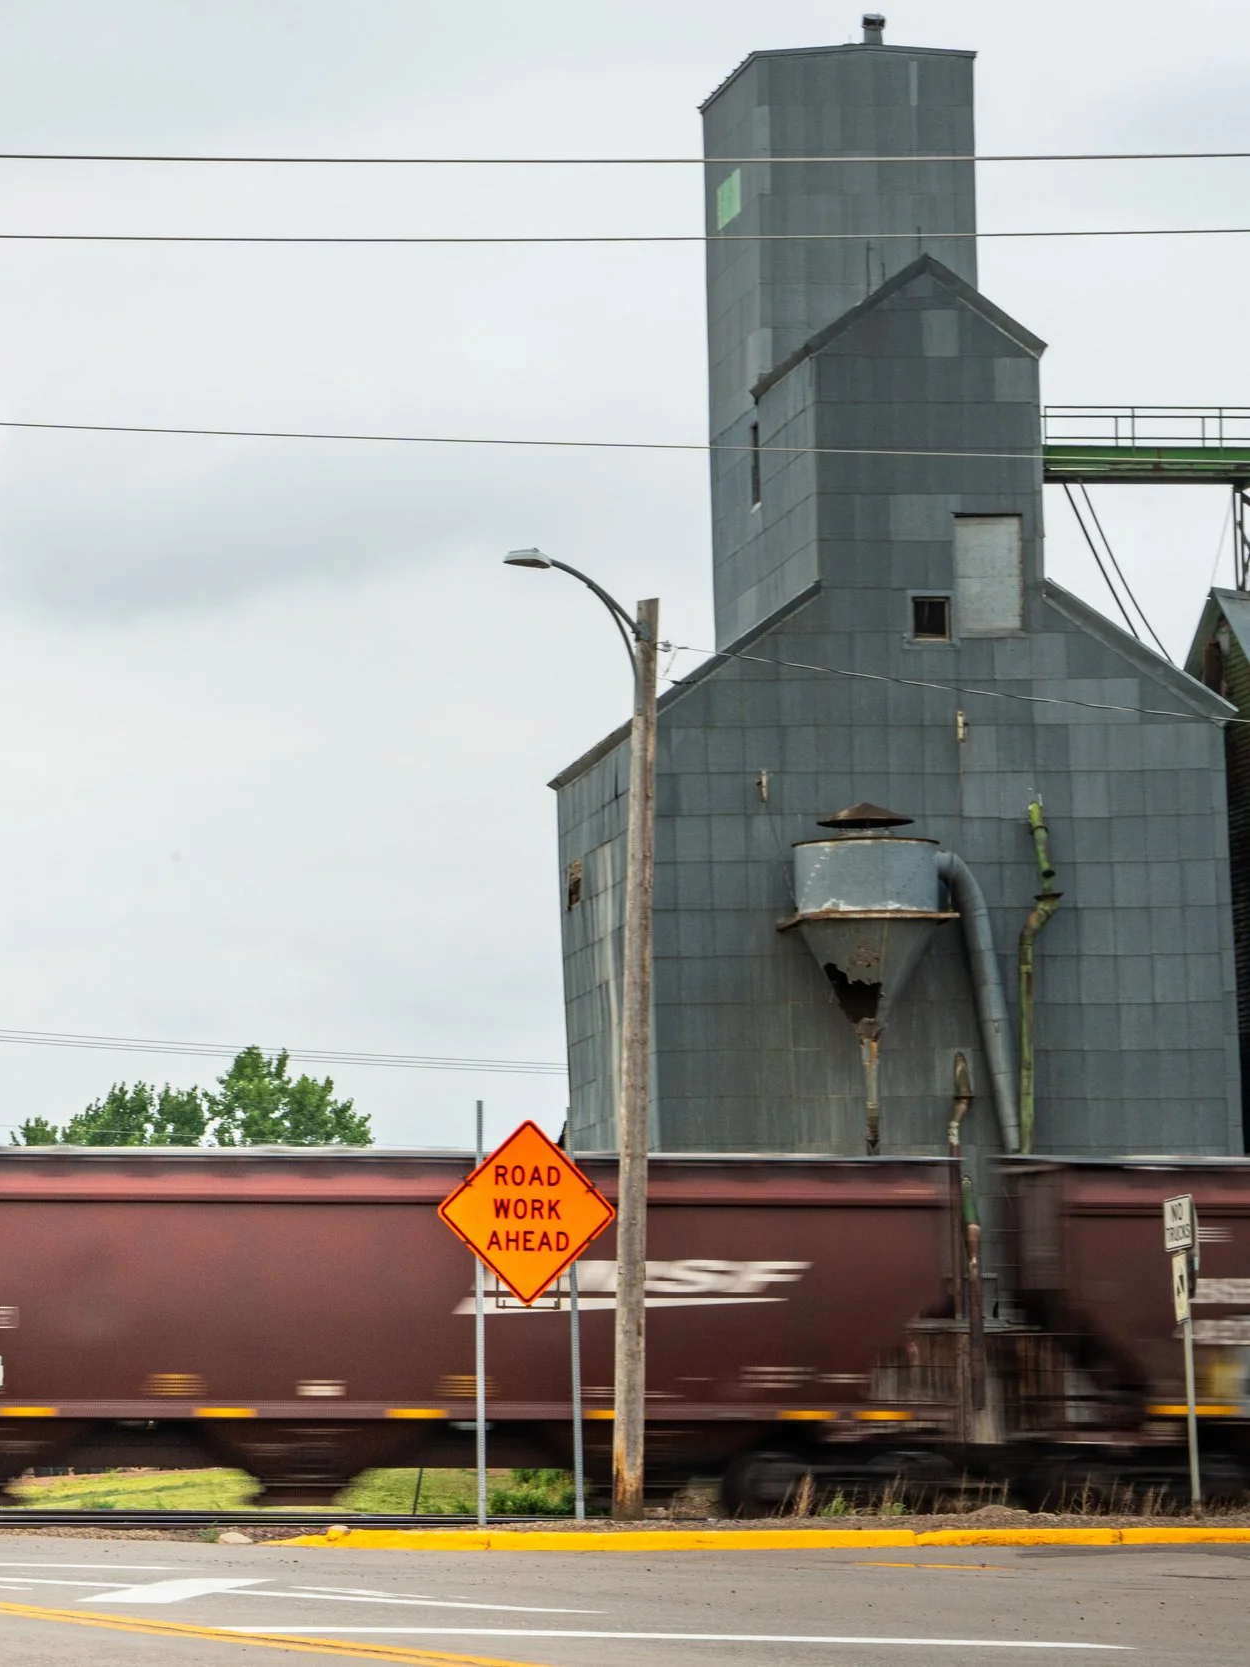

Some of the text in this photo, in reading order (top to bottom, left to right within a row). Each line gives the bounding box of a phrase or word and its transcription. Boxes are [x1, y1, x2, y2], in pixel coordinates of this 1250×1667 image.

[494, 1165, 561, 1187] ROAD
[494, 1198, 562, 1220] WORK
[1171, 1202, 1184, 1221] NO
[487, 1230, 570, 1251] AHEAD
[1166, 1223, 1191, 1242] TRUCKS
